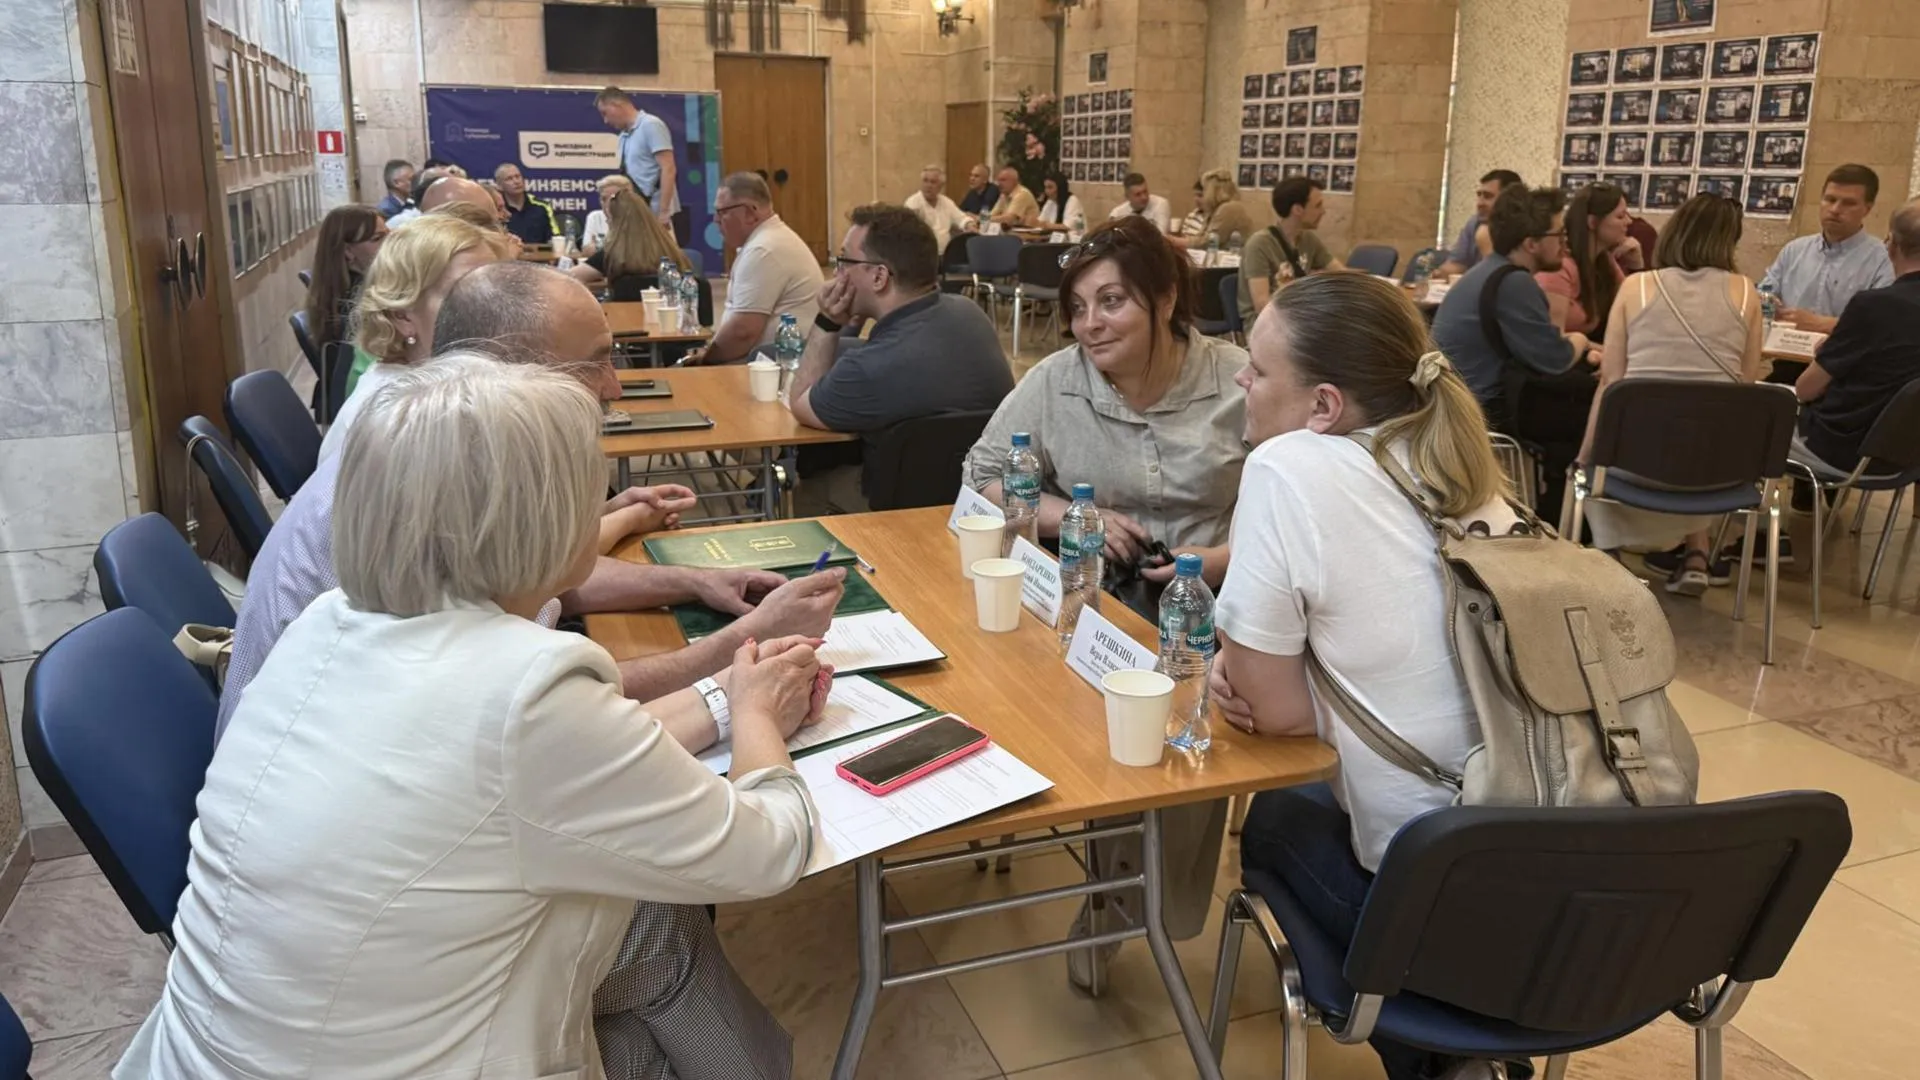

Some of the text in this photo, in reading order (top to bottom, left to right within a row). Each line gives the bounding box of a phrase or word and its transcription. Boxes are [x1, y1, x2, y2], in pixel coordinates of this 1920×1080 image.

[524, 179, 603, 193] ИНЯЕМС
[544, 198, 587, 211] МЕН
[1089, 644, 1103, 661] Вера
[1093, 630, 1137, 668] АРЕШКИНА
